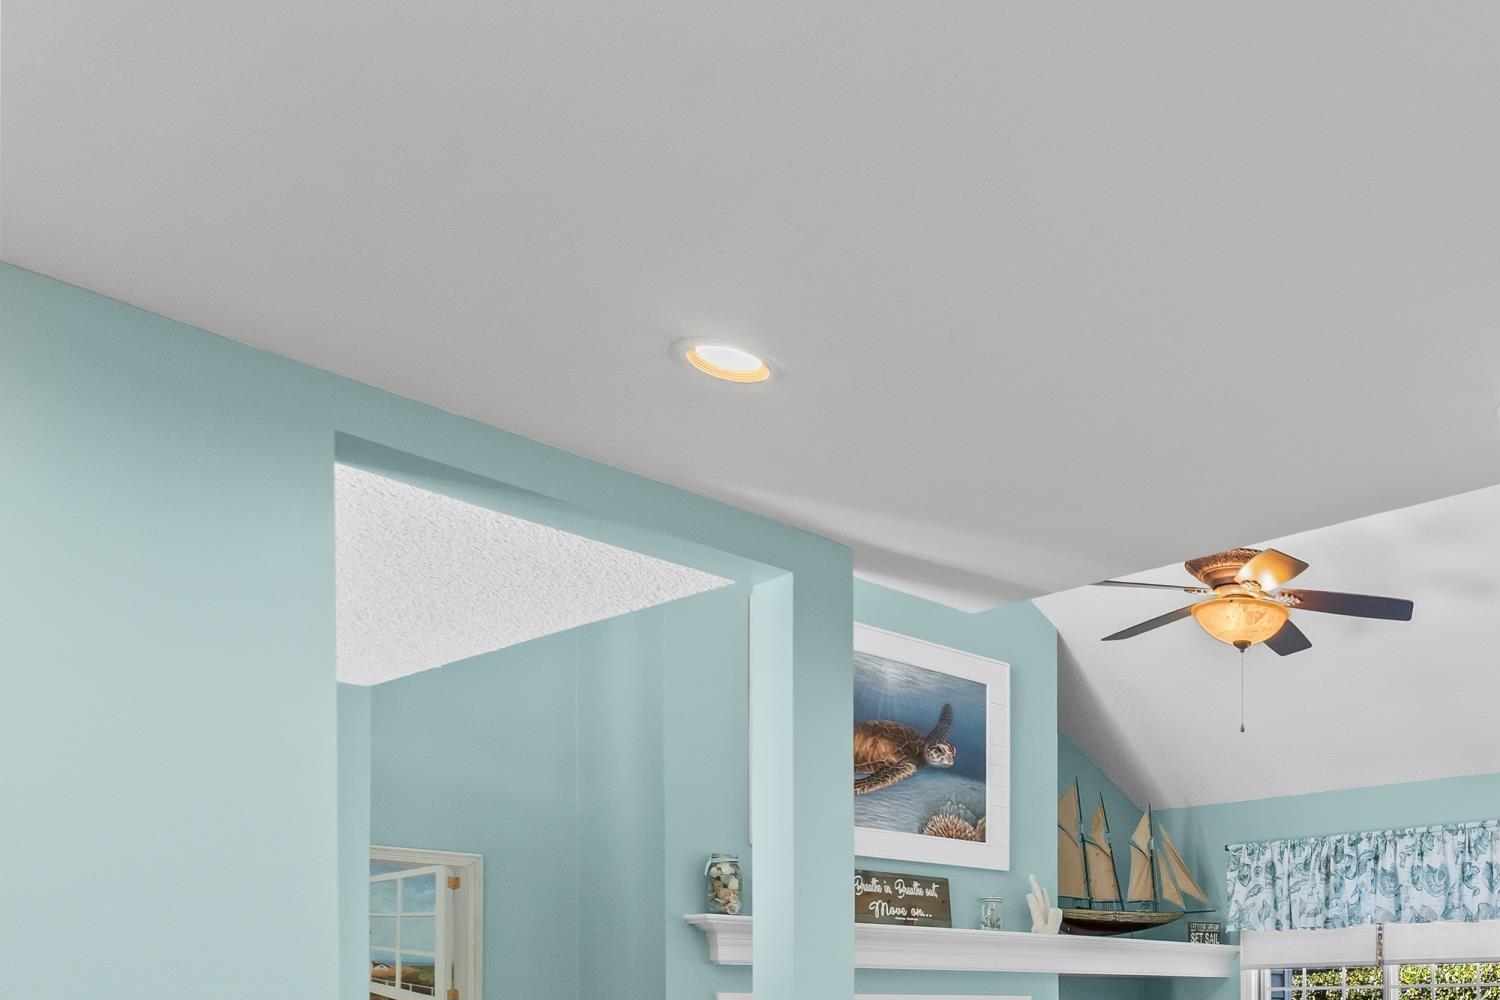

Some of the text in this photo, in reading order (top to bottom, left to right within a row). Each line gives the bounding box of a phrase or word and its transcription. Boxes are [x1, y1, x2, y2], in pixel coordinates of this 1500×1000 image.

[894, 878, 924, 899] Breathe
[868, 899, 908, 918] Move
[1190, 932, 1220, 945] SET SAIL
